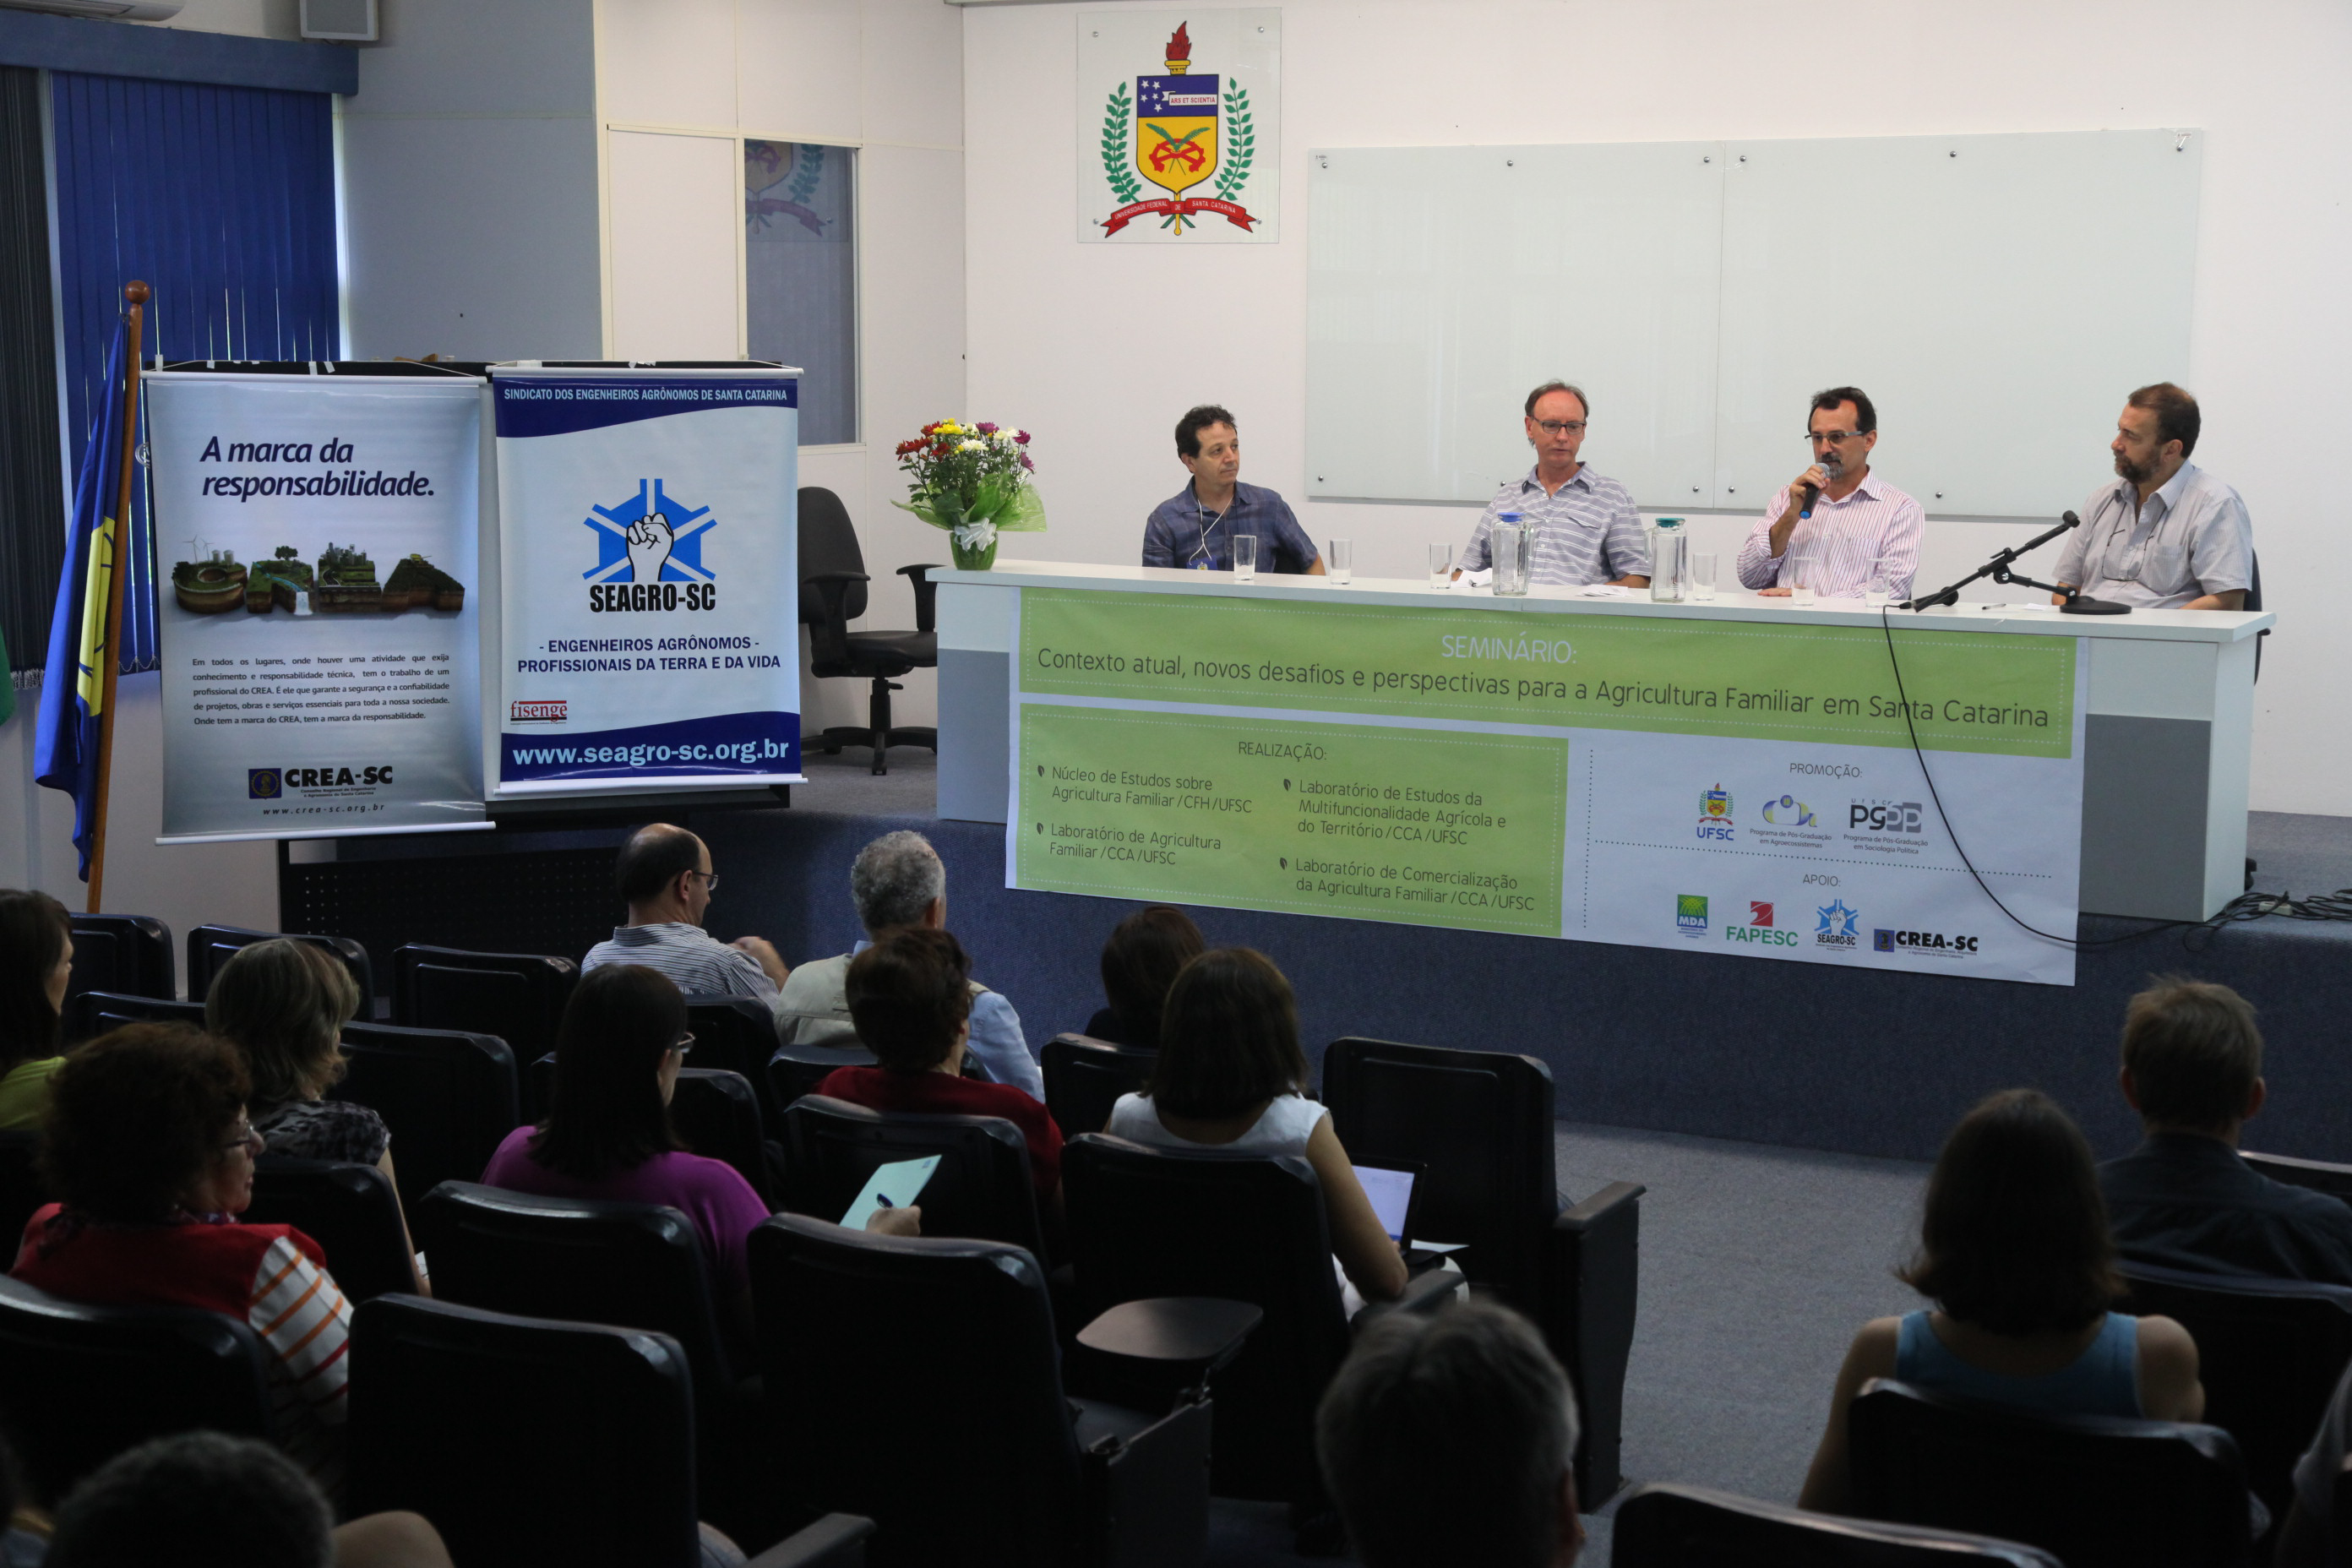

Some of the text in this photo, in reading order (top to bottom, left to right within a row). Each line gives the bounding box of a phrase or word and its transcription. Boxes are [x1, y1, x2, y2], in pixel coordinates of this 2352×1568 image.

[1115, 204, 1146, 219] UNIVERSIDADE
[1211, 202, 1236, 214] CATARINA
[504, 386, 787, 400] SINDICATO DOS ENGENHEIROS AGRÔNOMOS DE SANTA CATARINA
[199, 436, 354, 463] A marca da
[202, 471, 434, 502] responsabilidade.
[590, 584, 716, 612] SEAGRO-SC
[548, 634, 751, 652] ENGENHEIROS AGRÔNOMOS
[1441, 632, 1577, 664] SEMINÁRIO:
[255, 657, 286, 667] lugares,
[371, 654, 406, 662] atividade
[431, 653, 449, 662] exija
[518, 655, 781, 672] PROFISSIONAIS DA TERRA E DA VIDA
[193, 672, 247, 681] conhecimento
[259, 671, 324, 681] responsabilidade
[326, 670, 355, 678] técnica,
[193, 687, 237, 697] profissional
[275, 685, 280, 694] É
[312, 686, 340, 695] garante
[348, 685, 385, 694] segurança
[399, 682, 449, 690] confiabilidade
[1037, 647, 2048, 727] Contexto atual, novos desafios e perspectivas para a Agricultura Familiar em Santa Catarina
[205, 702, 239, 711] projetos,
[272, 701, 303, 710] serviços
[305, 700, 342, 708] essenciais
[411, 696, 449, 705] sociedade.
[510, 700, 567, 721] fisenge
[278, 715, 302, 723] CREA,
[362, 711, 426, 721] responsabilidade.
[513, 738, 789, 766] www.seagro-sc.org.br
[1239, 741, 1327, 762] REALIZAÇÃO:
[285, 765, 393, 787] CREA-SC
[1052, 765, 1212, 791] Núcleo de Estudos sobre
[1789, 763, 1863, 779] PROMOÇÃO:
[1052, 785, 1121, 803] Agricultura
[1299, 779, 1482, 806] Laboratório de Estudos da
[1298, 798, 1505, 828] Multifuncionalidade Agrícola e
[1298, 818, 1315, 833] do
[1696, 827, 1734, 841] UFSC
[1750, 828, 1778, 836] Programa
[1787, 830, 1832, 841] Pós-Graduação
[1051, 823, 1221, 850] Laboratório de Agricultura
[1770, 838, 1822, 848] Agroecossistemas
[1843, 833, 1872, 842] Programa
[1882, 836, 1928, 847] Pós-Graduação
[1864, 844, 1896, 853] Sociologia
[1897, 846, 1919, 854] Política
[1296, 858, 1517, 891] Laboratório de Comercialização
[1803, 874, 1841, 887] APOIO:
[1296, 876, 1312, 891] da
[1317, 879, 1391, 898] Agricultura
[1679, 916, 1706, 928] MDA
[1727, 926, 1799, 947] FAPESC
[1817, 934, 1856, 946] SEAGRO-SC
[1896, 931, 1979, 951] CREA-SC
